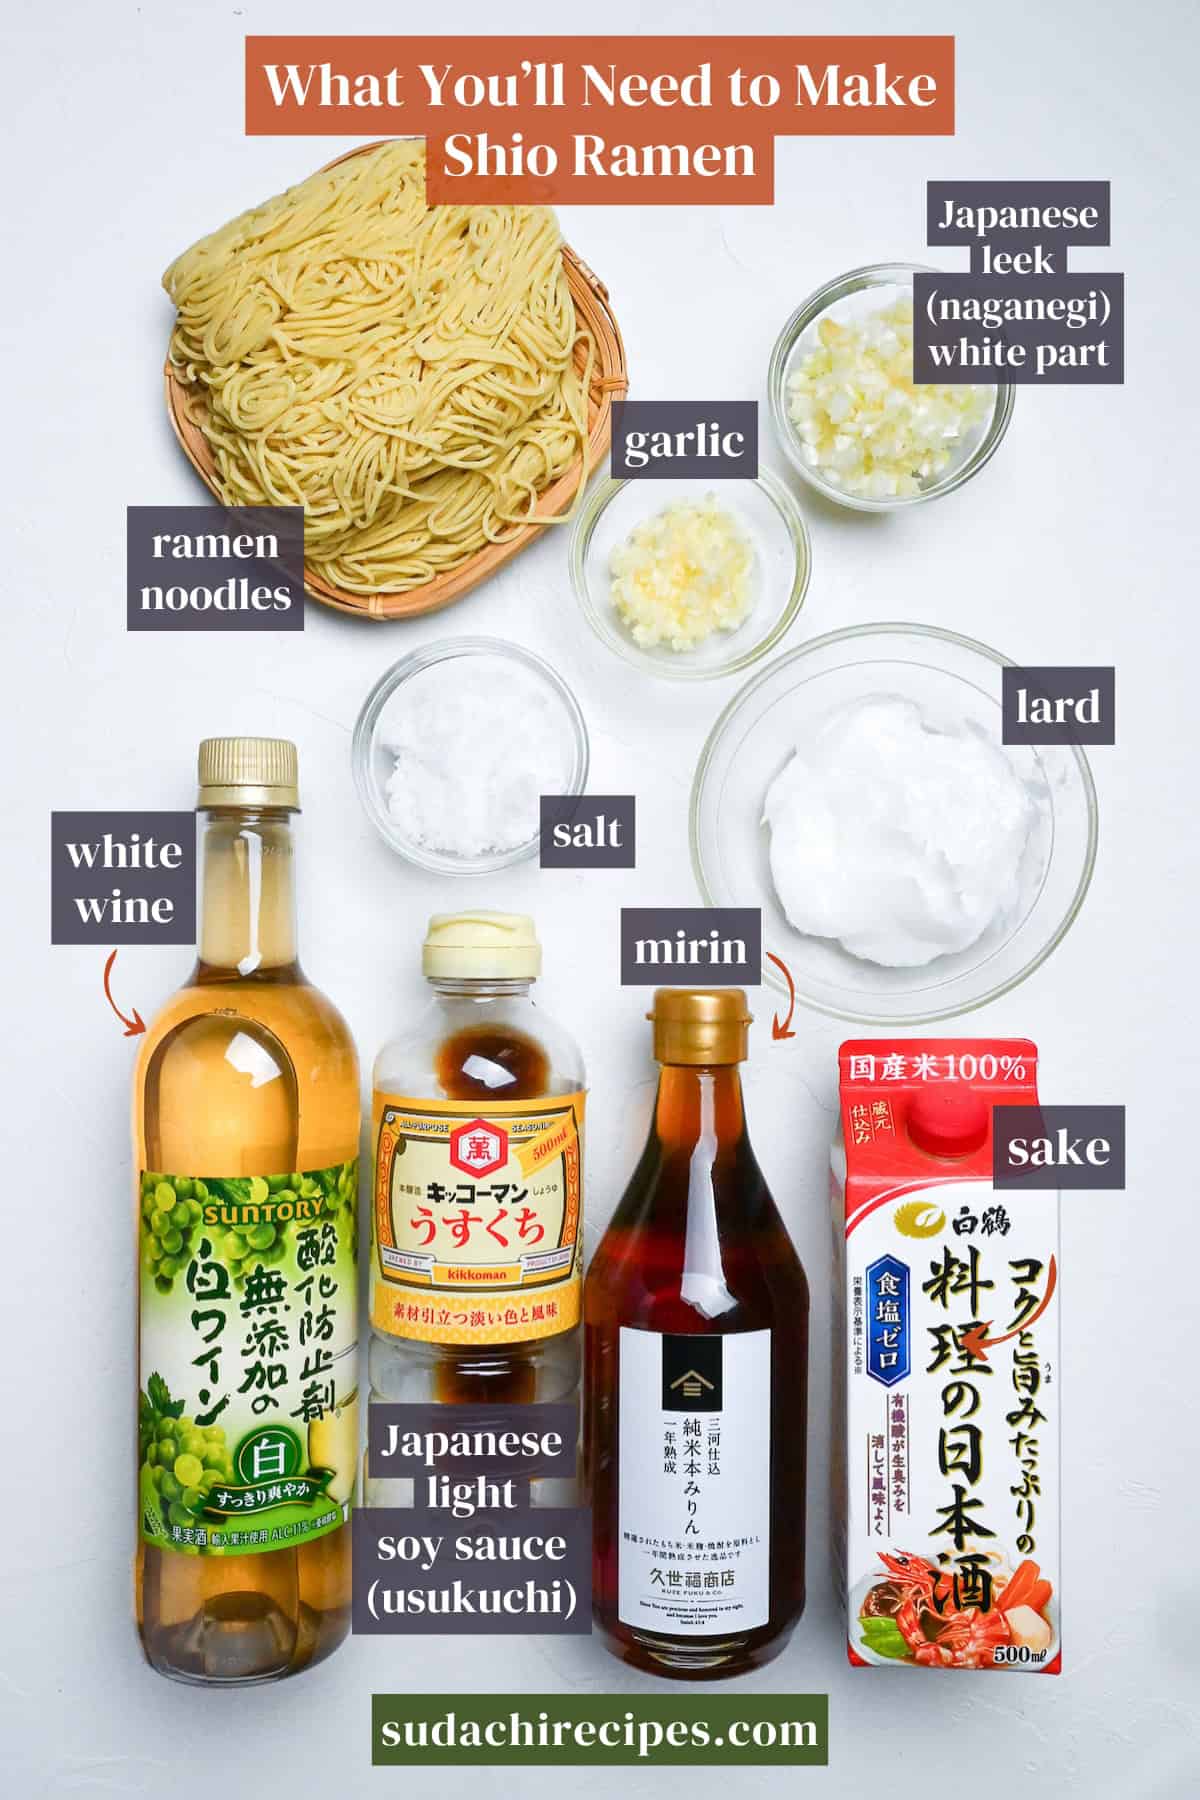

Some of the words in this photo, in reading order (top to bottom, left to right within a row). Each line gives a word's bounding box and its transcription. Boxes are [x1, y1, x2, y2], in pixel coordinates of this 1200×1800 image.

[850, 1053, 1026, 1082] 国産米100%
[851, 1105, 871, 1144] 仕込み
[204, 1197, 324, 1225] SUNTORY
[427, 1182, 529, 1204] キッコーマン
[533, 1183, 558, 1197] しょうゆ
[410, 1205, 545, 1249] うすくち
[952, 1205, 1011, 1237] 白鶴
[447, 1268, 507, 1281] kikkoman
[186, 1238, 231, 1426] 白ワイン
[291, 1223, 339, 1423] 酸化防止剤
[393, 1301, 559, 1328] 素材引立つ淡い色と風味
[875, 1271, 903, 1369] 食塩ゼロ
[238, 1264, 290, 1414] 無添加の
[1006, 1258, 1046, 1553] コクと旨みたっぷりの
[663, 1421, 677, 1475] 一年熟成
[707, 1417, 721, 1476] 三河仕込
[922, 1245, 997, 1615] 料理の日本酒
[253, 1438, 286, 1479] 白
[890, 1394, 906, 1512] 有機酸が生臭みを
[216, 1483, 311, 1508] すっきり爽やか
[682, 1417, 702, 1536] 純米本みりん
[871, 1434, 887, 1536] 消して風味よく
[170, 1525, 208, 1546] 果実酒
[212, 1527, 269, 1546] 輸入果汁使用
[650, 1567, 735, 1589] 久世福商店
